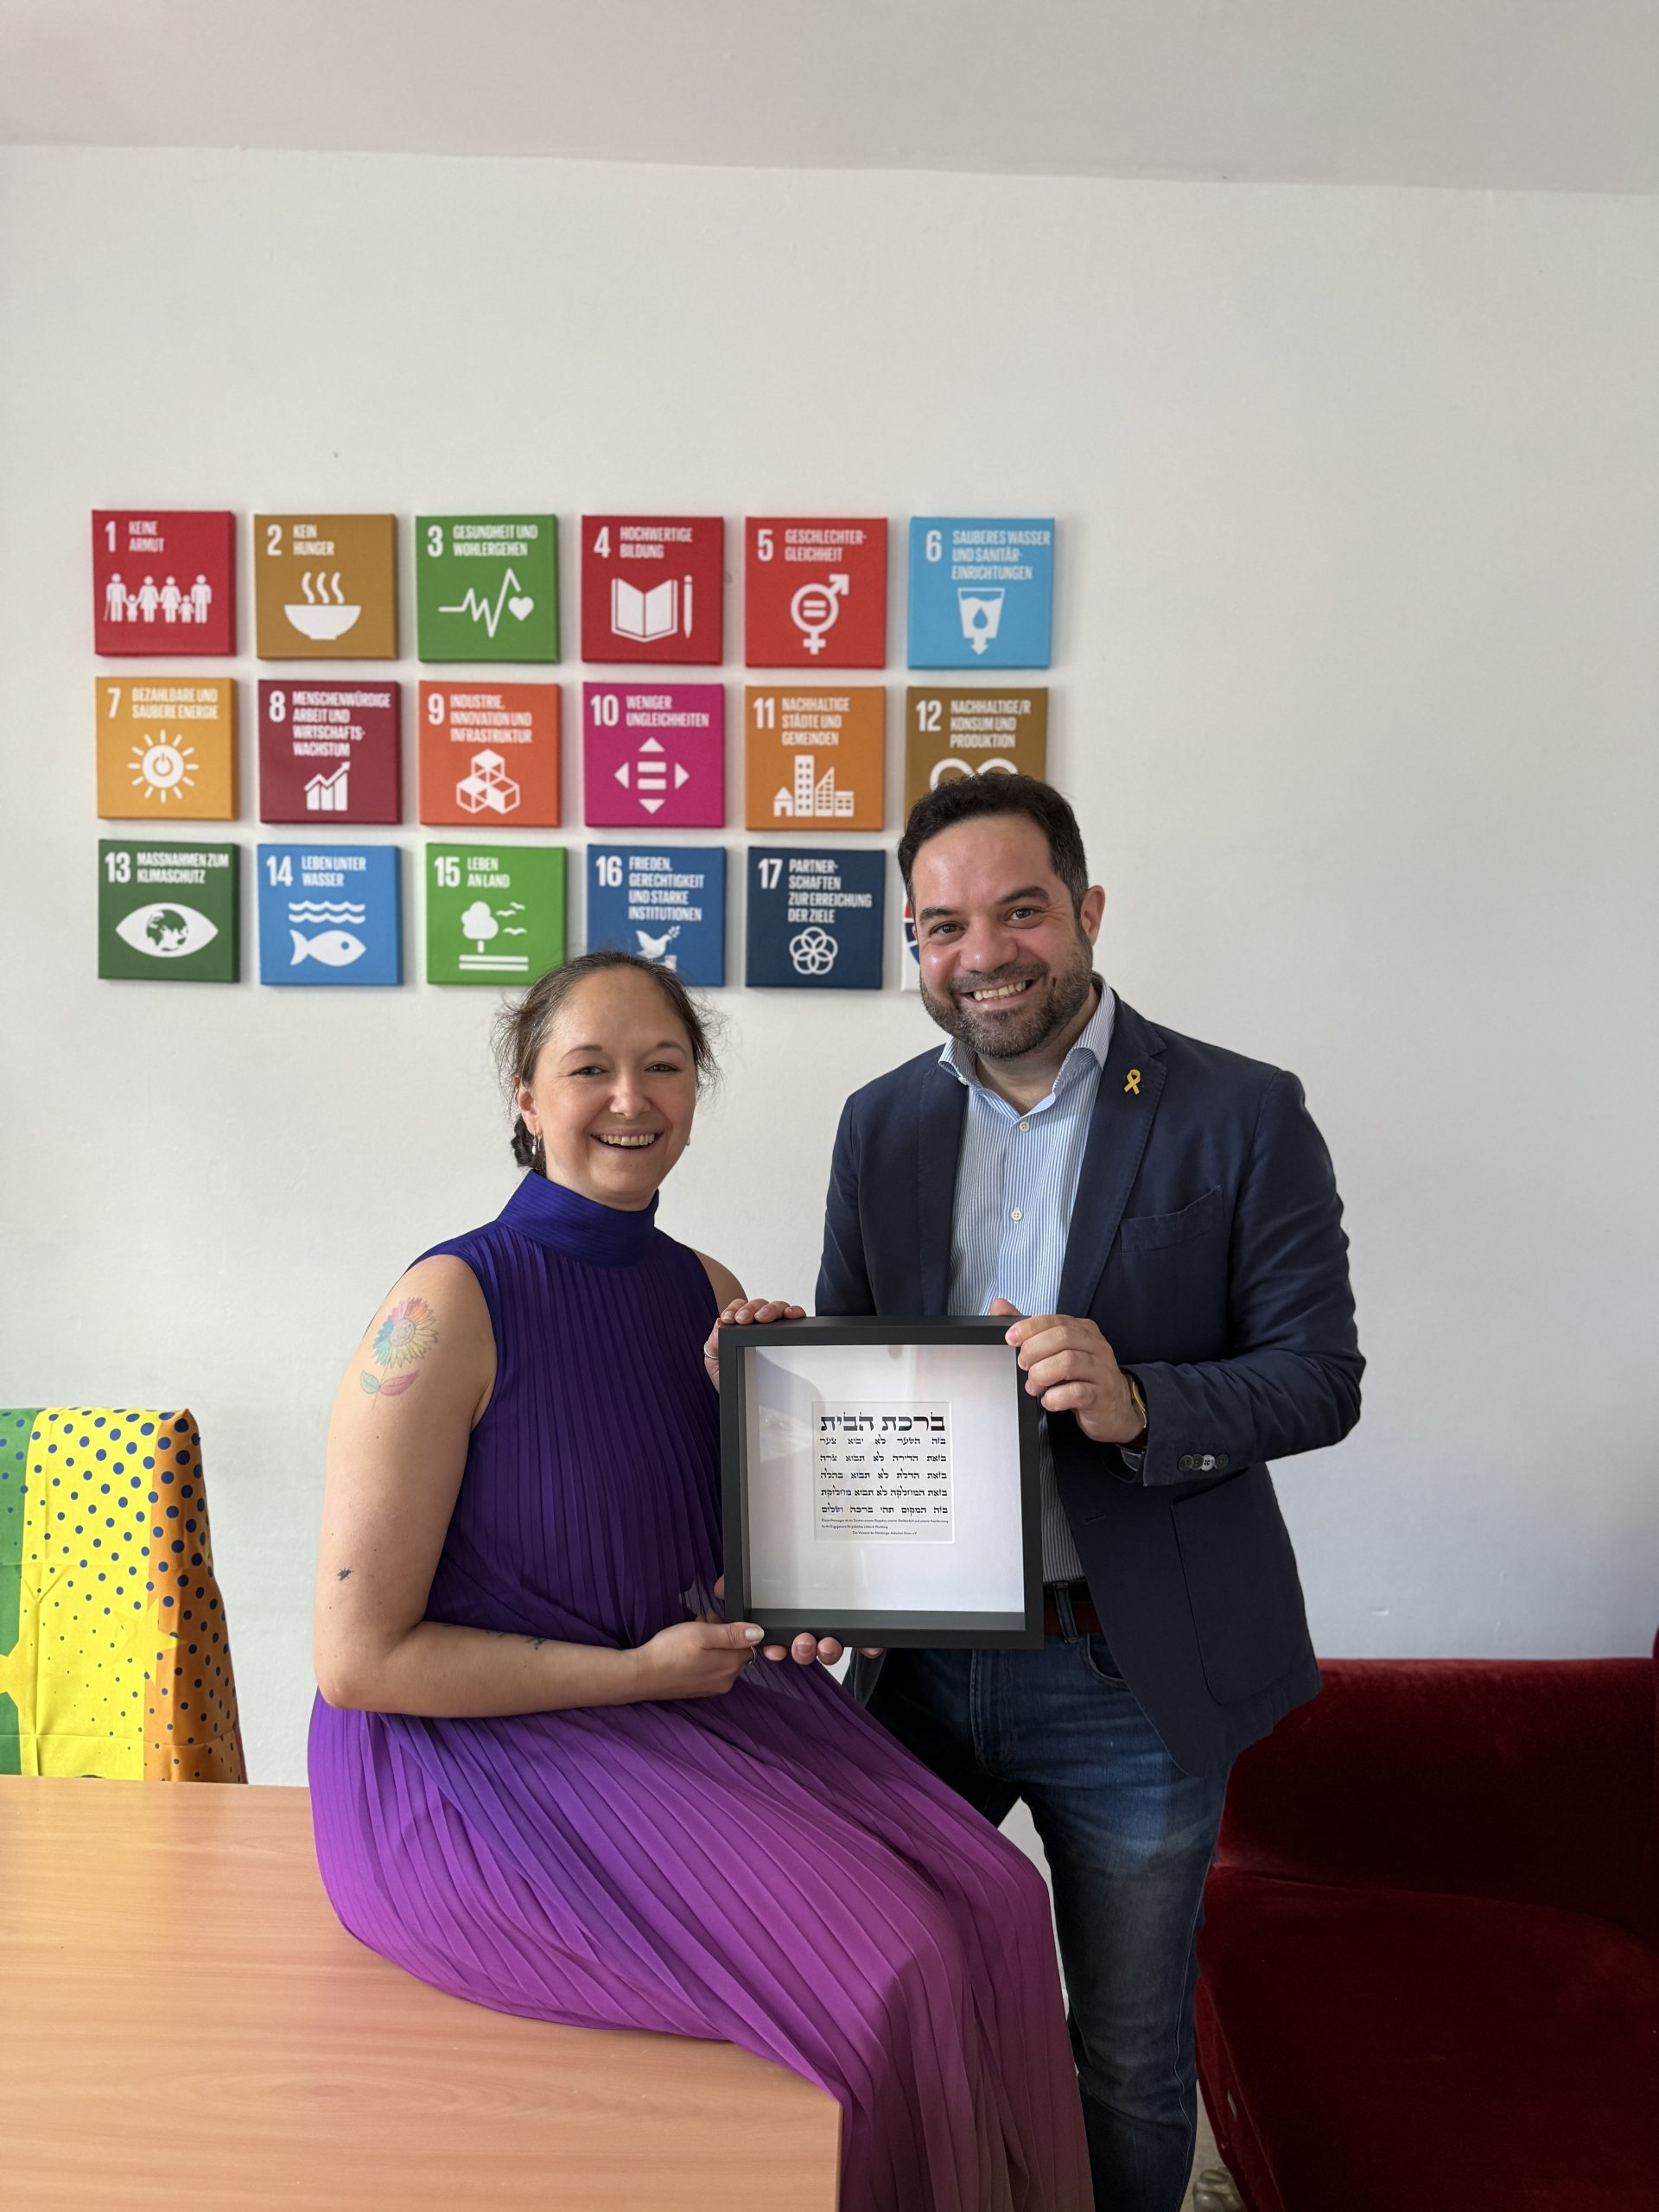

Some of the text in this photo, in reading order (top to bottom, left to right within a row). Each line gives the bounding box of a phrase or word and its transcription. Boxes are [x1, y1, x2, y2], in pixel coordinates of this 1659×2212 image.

[128, 520, 157, 536] KEINE
[294, 524, 316, 538] KEIN
[453, 524, 537, 539] GESUNDHEIT UND
[620, 526, 693, 543] HOCHWERTIGE
[105, 520, 116, 552] 1
[267, 524, 282, 556] 2
[428, 525, 443, 557] 3
[593, 526, 610, 558] 4
[785, 529, 867, 544] GESCHLECHTER-
[952, 531, 1051, 545] SAUBERES WASSER
[128, 537, 164, 552] ARMUT
[293, 541, 335, 556] HUNGER
[453, 542, 528, 556] WOHLERGEHEN
[620, 543, 664, 558] BILDUNG
[758, 529, 773, 562] 5
[926, 530, 942, 562] 6
[785, 546, 843, 562] GLEICHHEIT
[952, 546, 1023, 562] UND SANITÄR-
[952, 565, 1033, 580] EINRICHTUNGEN
[196, 688, 218, 703] UND
[292, 690, 391, 709] MENSCHENWÜRDIGE
[626, 695, 672, 709] WENIGER
[107, 688, 121, 719] 7
[269, 690, 285, 722] 8
[428, 693, 444, 725] 9
[591, 694, 619, 726] 10
[781, 697, 850, 712] NACHHALTIGE
[950, 700, 1032, 715] NACHHALTIGE/R
[178, 705, 219, 719] ENERGIE
[293, 709, 351, 722] ARBEIT UND
[450, 711, 532, 726] INNOVATION UND
[753, 697, 774, 729] 11
[916, 700, 942, 732] 12
[626, 712, 709, 728] UNGLEICHHEITEN
[781, 714, 842, 728] STÄDTE UND
[950, 717, 1016, 731] KONSUM UND
[292, 725, 365, 741] WIRTSCHAFTS-
[450, 728, 532, 743] INFRASTRUKTUR
[781, 731, 839, 746] GEMEINDEN
[950, 734, 1015, 748] PRODUKTION
[292, 741, 350, 757] WACHSTUM
[105, 852, 130, 883] 13
[137, 852, 229, 868] MASSNAHMEN ZUM
[302, 855, 366, 871] LEBEN UNTER
[467, 857, 498, 871] LEBEN
[789, 859, 838, 874] PARTNER-
[137, 868, 206, 884] KLIMASCHUTZ
[266, 855, 294, 887] 14
[434, 856, 461, 887] 15
[595, 855, 622, 887] 16
[758, 858, 783, 889] 17
[302, 873, 344, 887] WASSER
[467, 874, 510, 888] AN LAND
[629, 873, 705, 888] GERECHTIGKEIT
[788, 874, 841, 890] SCHAFTEN
[629, 890, 689, 905] UND STARKE
[788, 892, 872, 907] ZUR ERREICHUNG
[628, 906, 702, 921] INSTITUTIONEN
[788, 909, 836, 923] DER ZIELE
[821, 1412, 945, 1431] ברכת הבית
